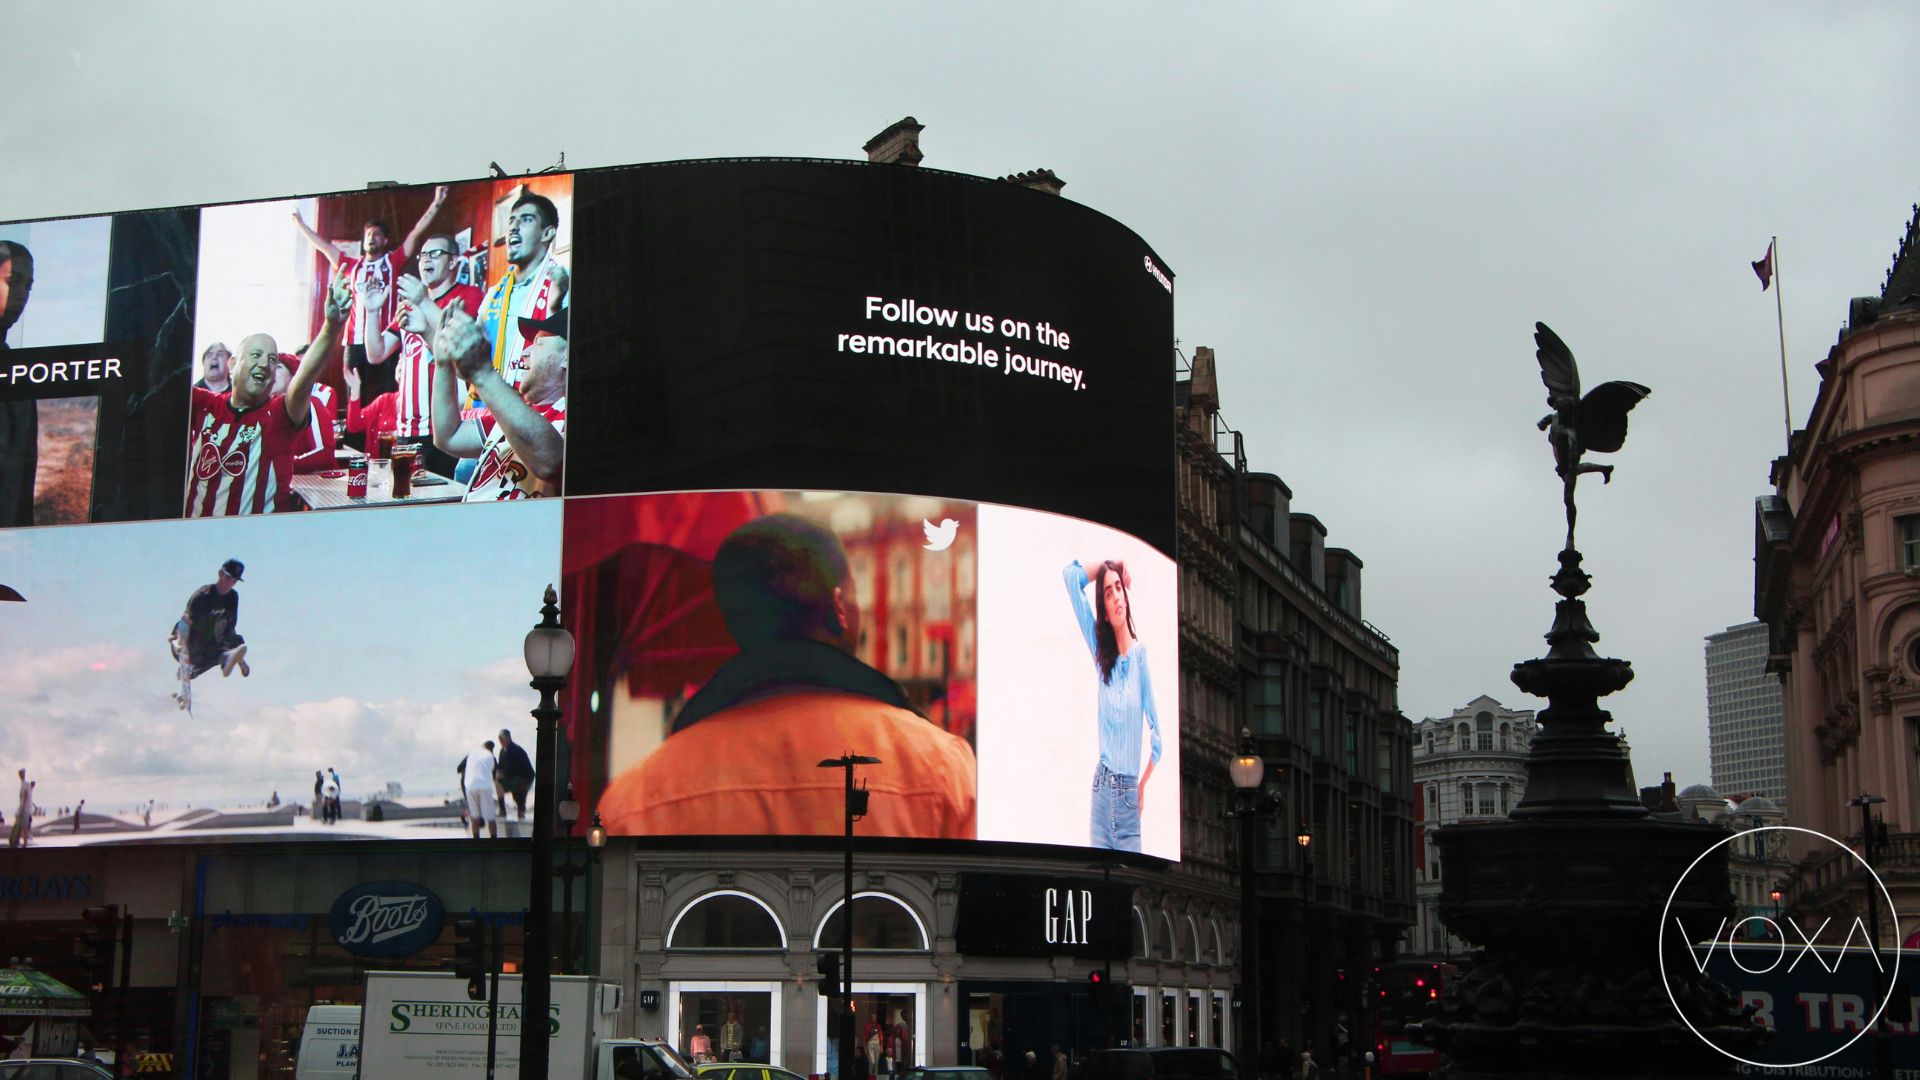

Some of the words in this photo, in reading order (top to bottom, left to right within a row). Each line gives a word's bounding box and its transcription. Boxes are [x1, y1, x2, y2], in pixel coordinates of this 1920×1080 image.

[865, 296, 958, 327] Follow
[964, 313, 994, 333] us
[1001, 319, 1031, 341] on
[1036, 322, 1070, 350] the
[837, 332, 998, 367] remarkable
[1004, 346, 1087, 391] journey.
[338, 893, 428, 944] Boots
[1045, 887, 1093, 944] GAP
[316, 1027, 351, 1035] SUCTION
[463, 1023, 490, 1032] FOOD
[1762, 1065, 1864, 1080] DISTRIBUTION
